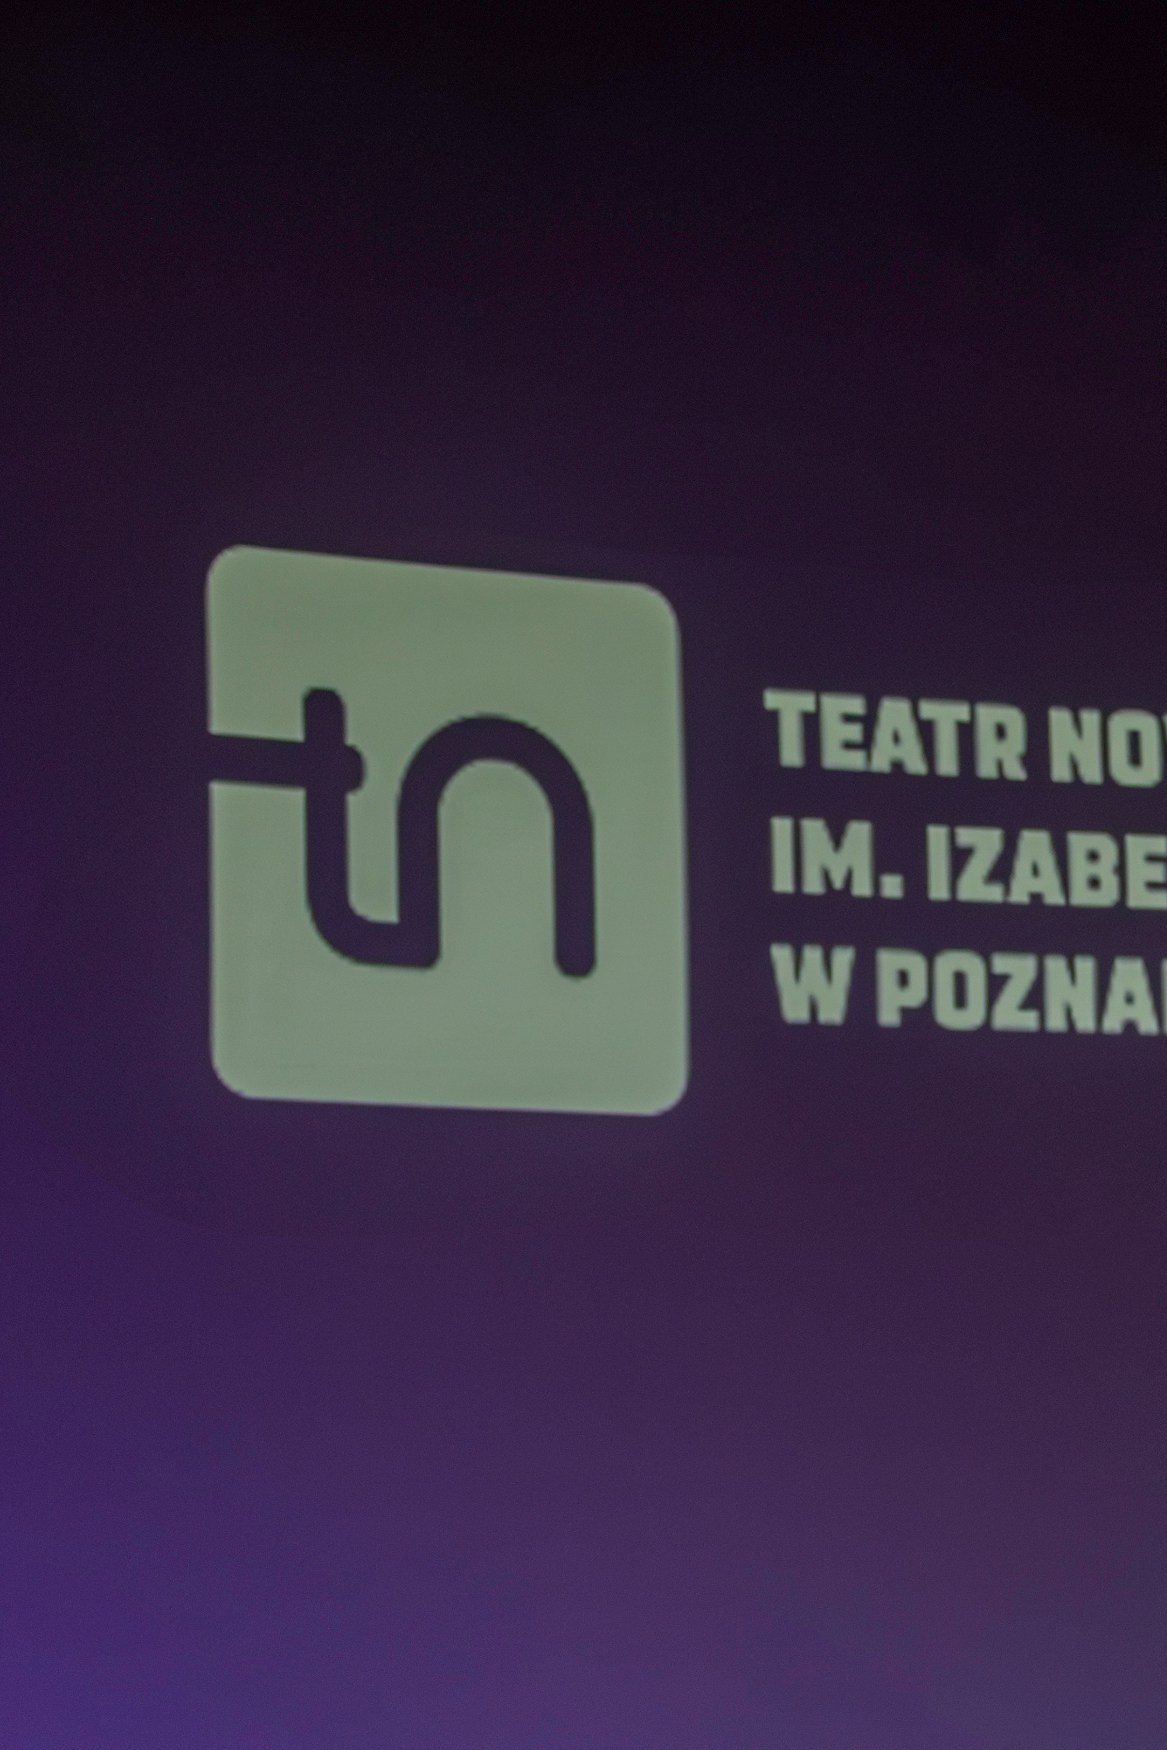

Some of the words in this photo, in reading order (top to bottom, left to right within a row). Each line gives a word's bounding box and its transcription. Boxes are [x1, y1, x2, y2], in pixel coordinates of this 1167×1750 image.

[763, 688, 1027, 781] TEATR
[769, 815, 903, 900] IM.
[770, 943, 855, 1026] W
